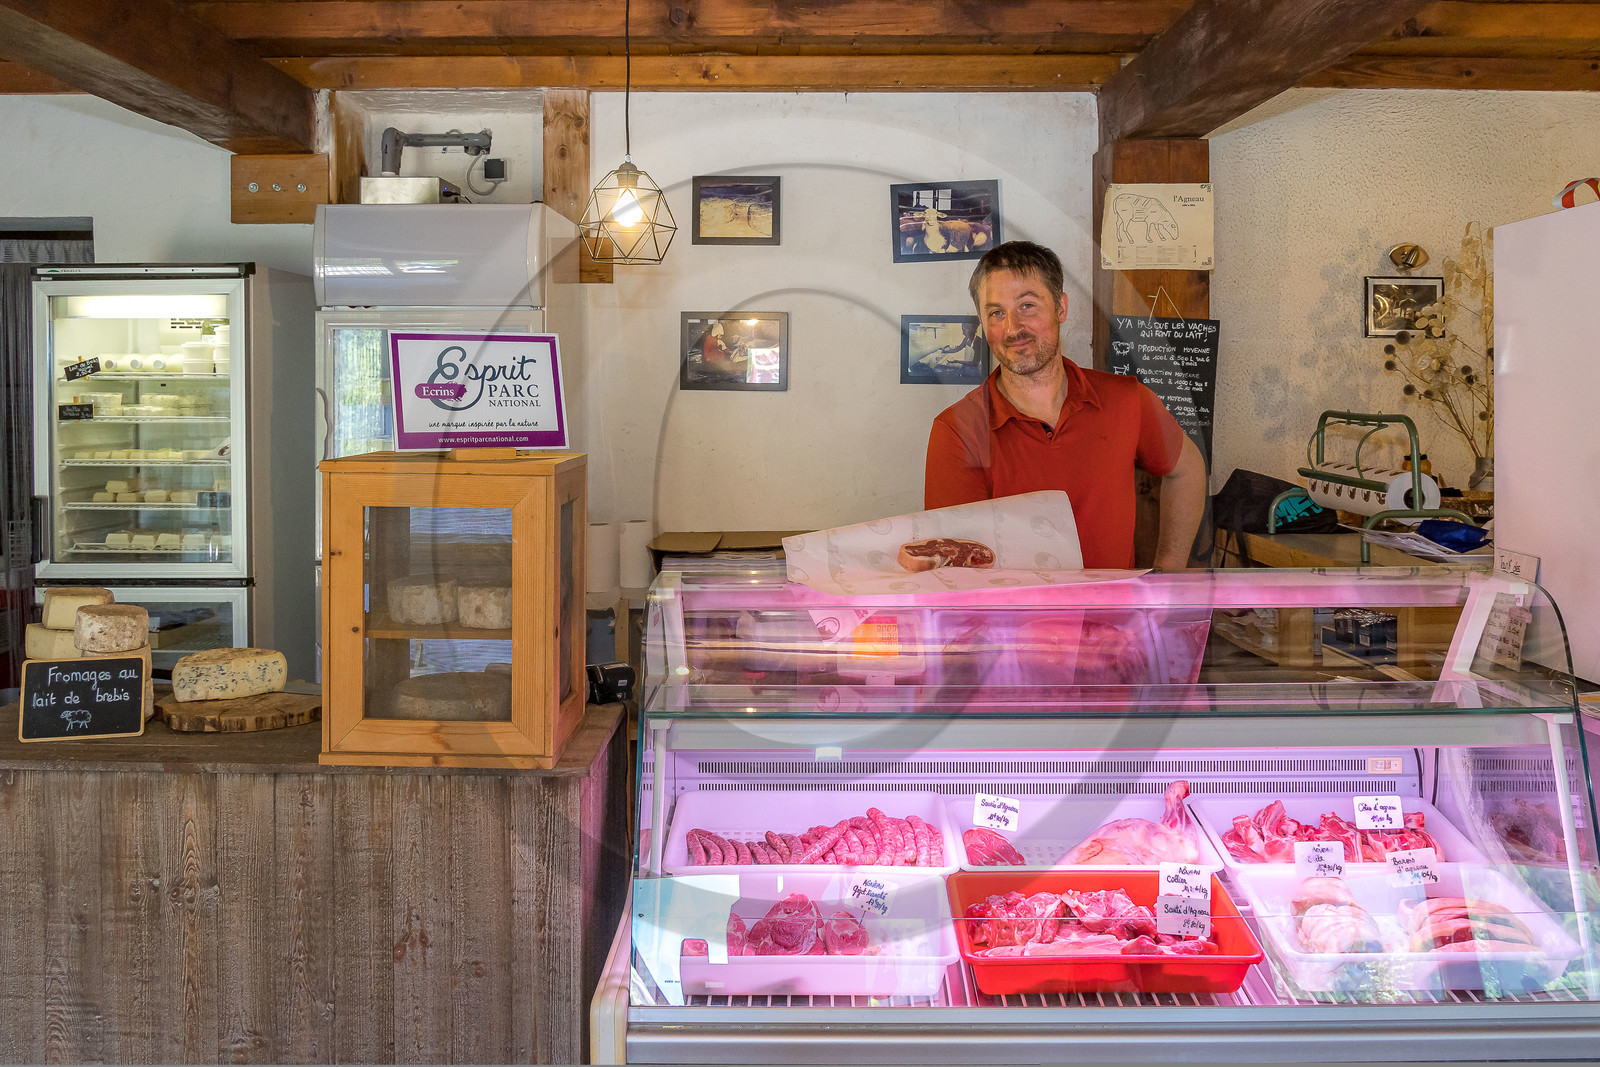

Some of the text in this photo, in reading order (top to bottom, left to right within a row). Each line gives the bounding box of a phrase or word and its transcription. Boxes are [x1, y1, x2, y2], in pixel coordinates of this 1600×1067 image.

[1173, 195, 1205, 203] l'Agneau
[1153, 321, 1169, 330] QUE
[1171, 322, 1185, 330] LES
[1187, 322, 1217, 333] VACHES
[1173, 330, 1184, 339] DU
[427, 345, 537, 411] Esprit
[422, 386, 455, 397] Ecrins
[488, 384, 540, 398] PARC
[489, 399, 541, 407] NATIONAL
[1167, 394, 1193, 403] MOYENNE
[441, 421, 466, 429] marque
[468, 419, 494, 430] inspirée
[496, 421, 508, 430] par
[508, 418, 517, 427] la
[517, 418, 539, 427] nature
[438, 436, 529, 444] www.espritparcnational.com
[48, 665, 139, 691] Fromages au
[32, 687, 130, 709] lait de brebis
